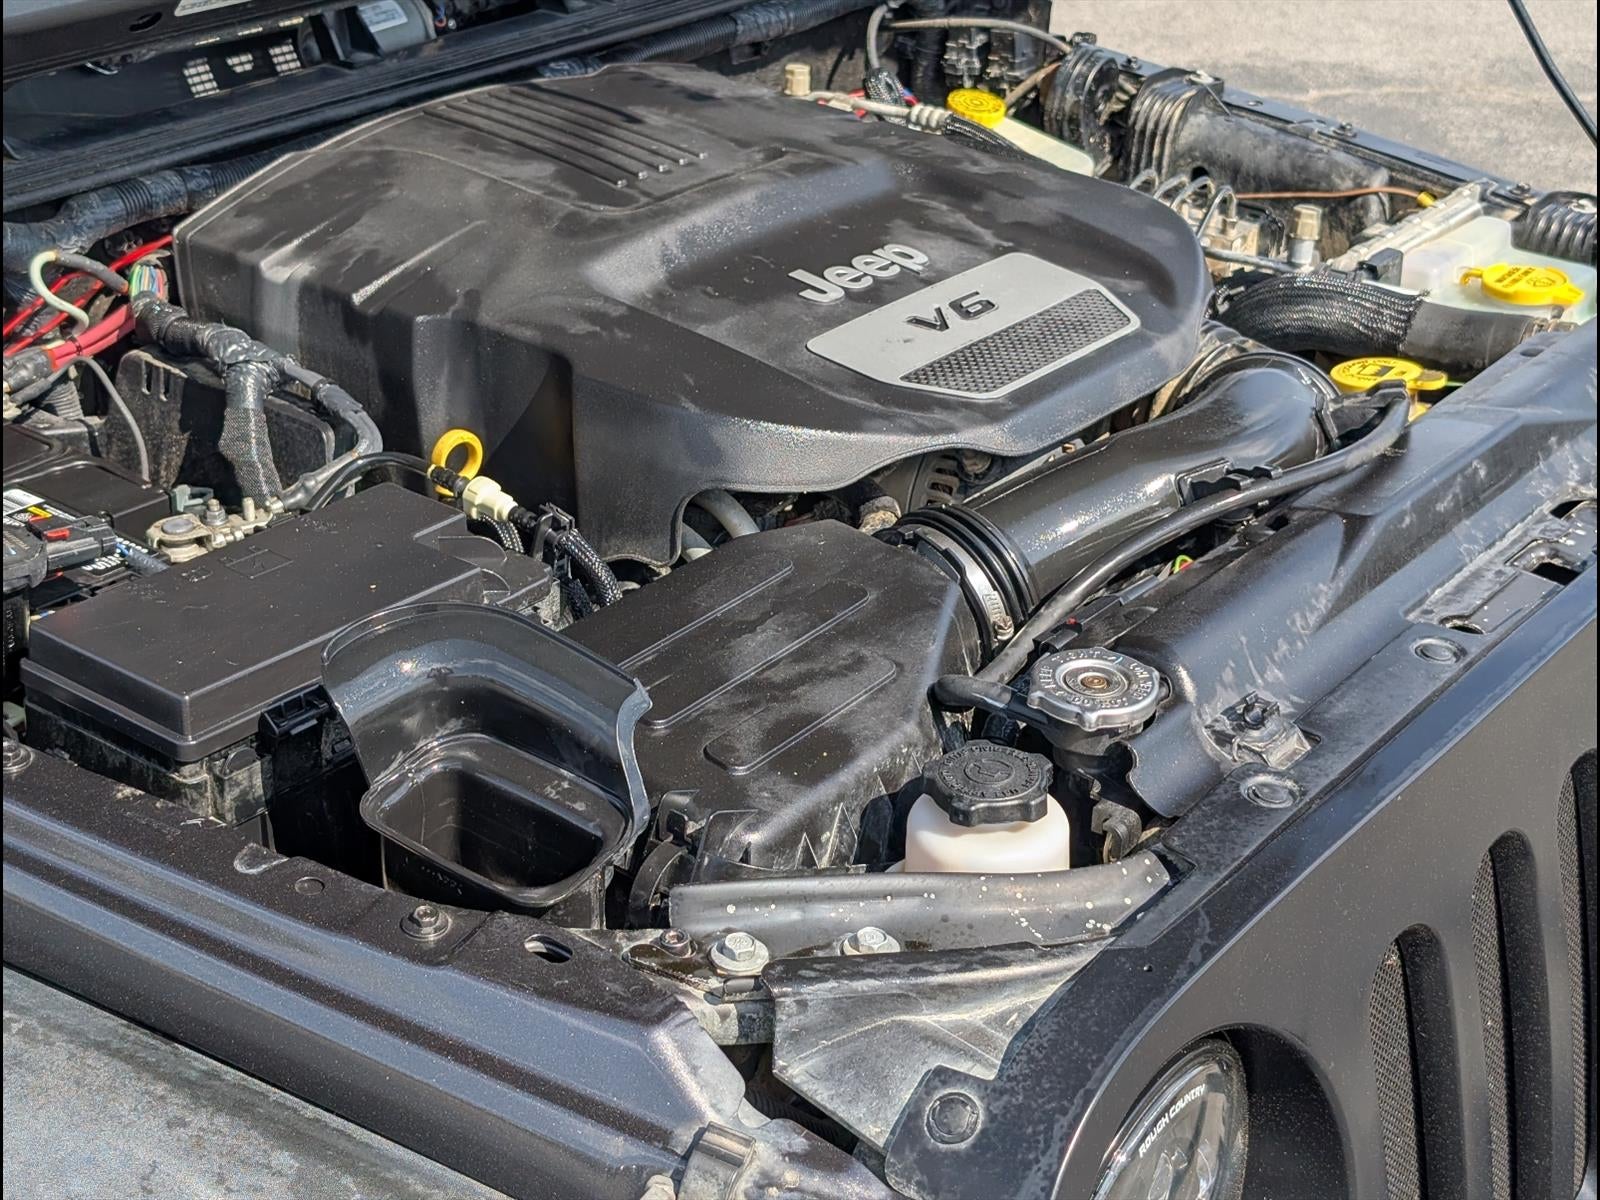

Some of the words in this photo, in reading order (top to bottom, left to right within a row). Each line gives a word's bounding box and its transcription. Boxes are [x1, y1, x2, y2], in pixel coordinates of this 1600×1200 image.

[788, 243, 930, 304] Jeep
[905, 290, 998, 333] V6
[1138, 1113, 1170, 1159] ROUGH
[1169, 1083, 1206, 1119] COUNTRY
